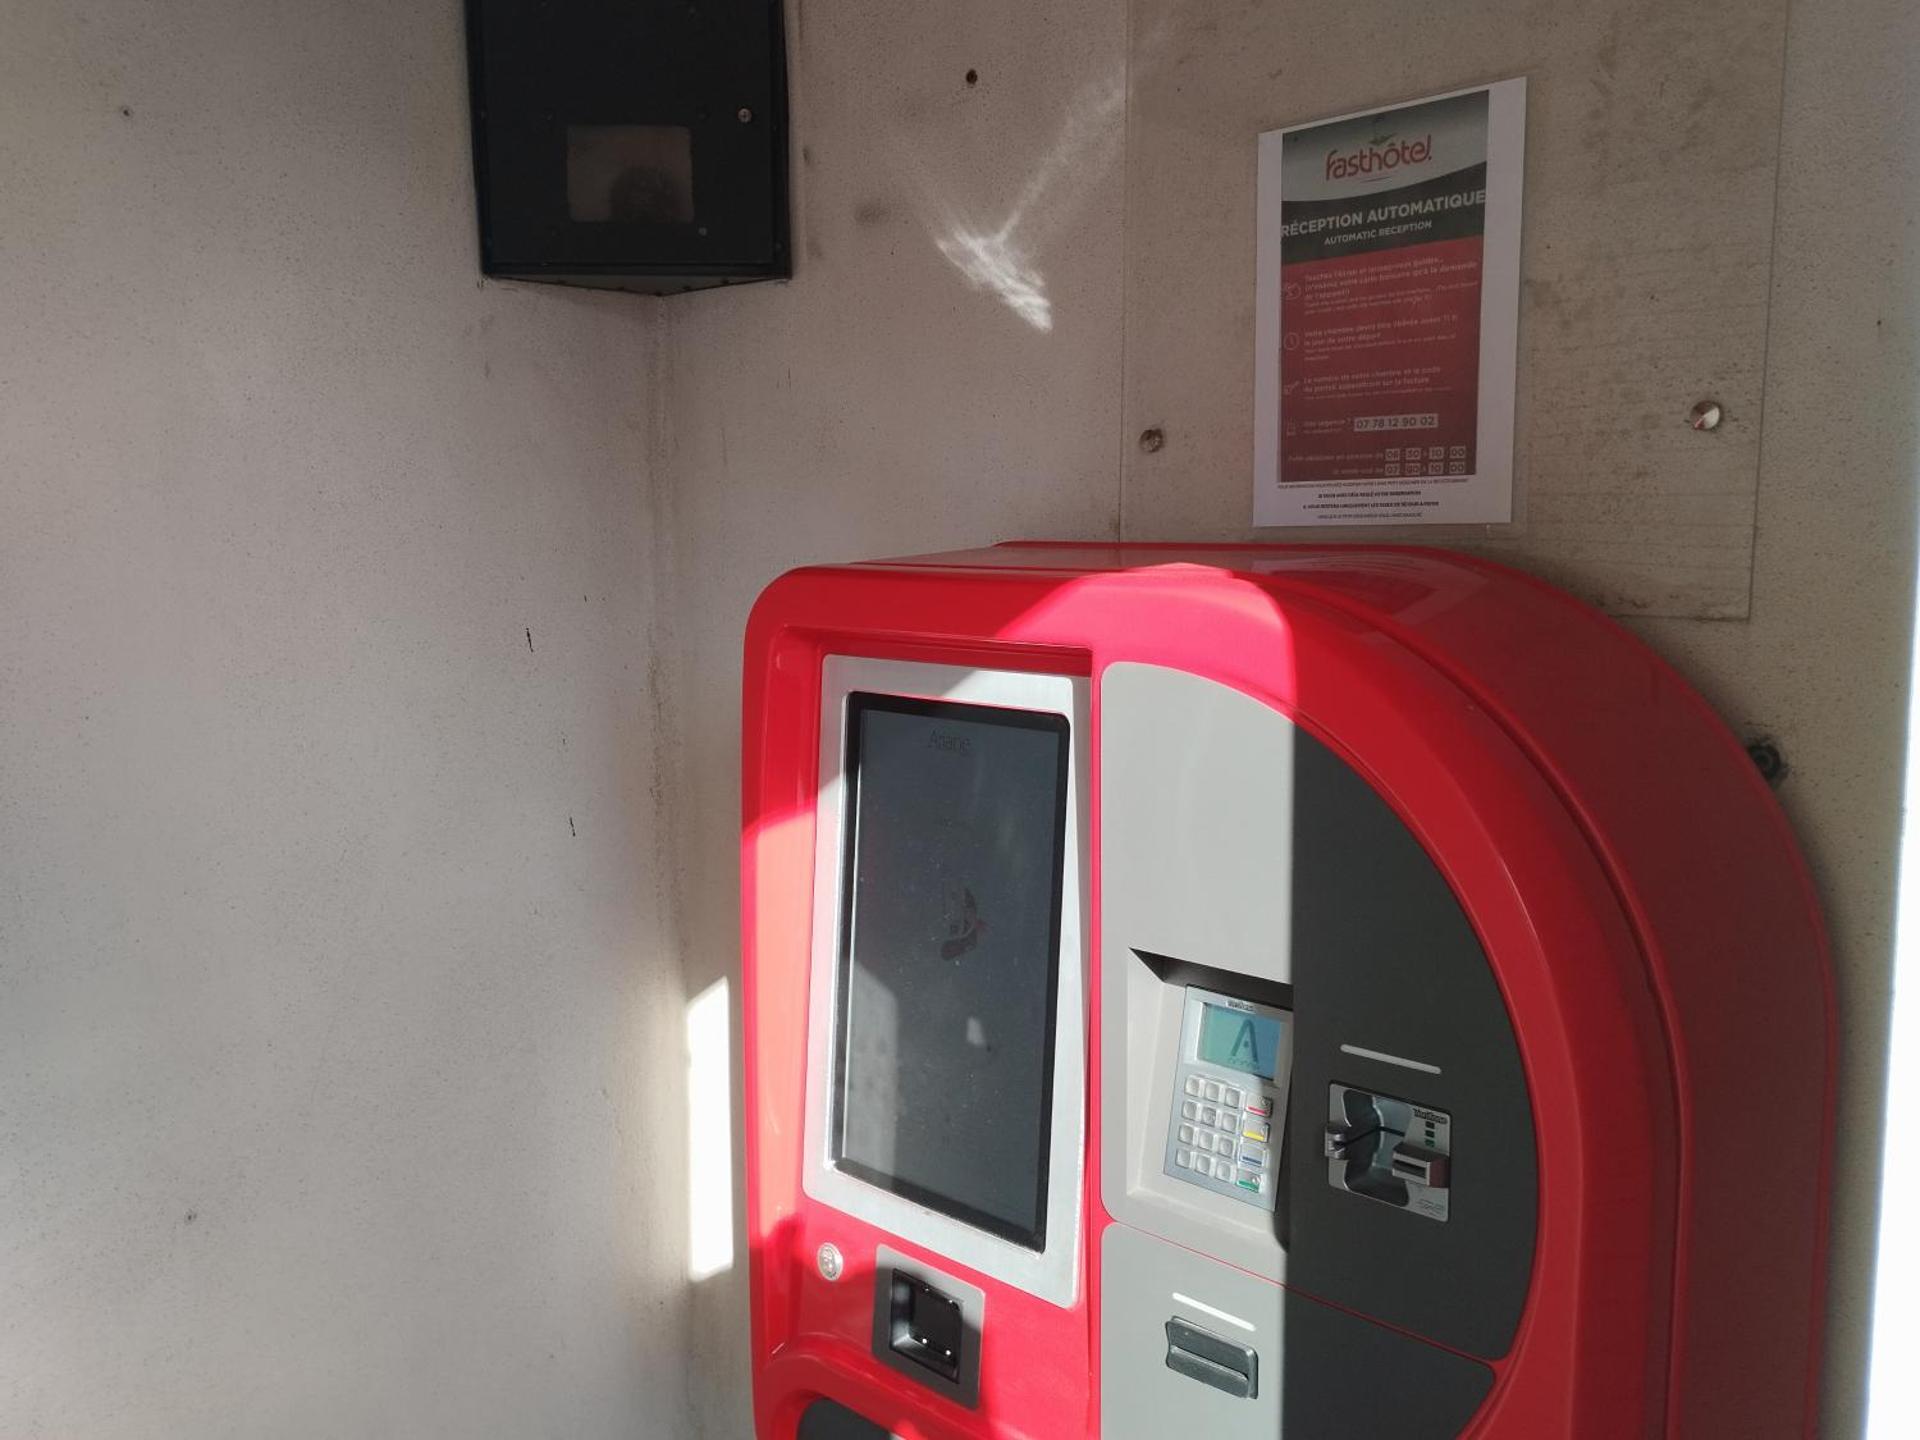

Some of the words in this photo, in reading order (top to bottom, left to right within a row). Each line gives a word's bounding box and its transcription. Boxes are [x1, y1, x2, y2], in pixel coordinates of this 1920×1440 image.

[1281, 211, 1363, 238] RÉCEPTION
[1367, 190, 1486, 222] AUTOMATIQUE
[1325, 229, 1377, 246] AUTOMATIC
[1379, 220, 1433, 237] RECEPTION
[1356, 419, 1369, 430] 07
[1388, 417, 1399, 427] 12
[1402, 416, 1417, 427] 90
[1420, 415, 1434, 426] 02
